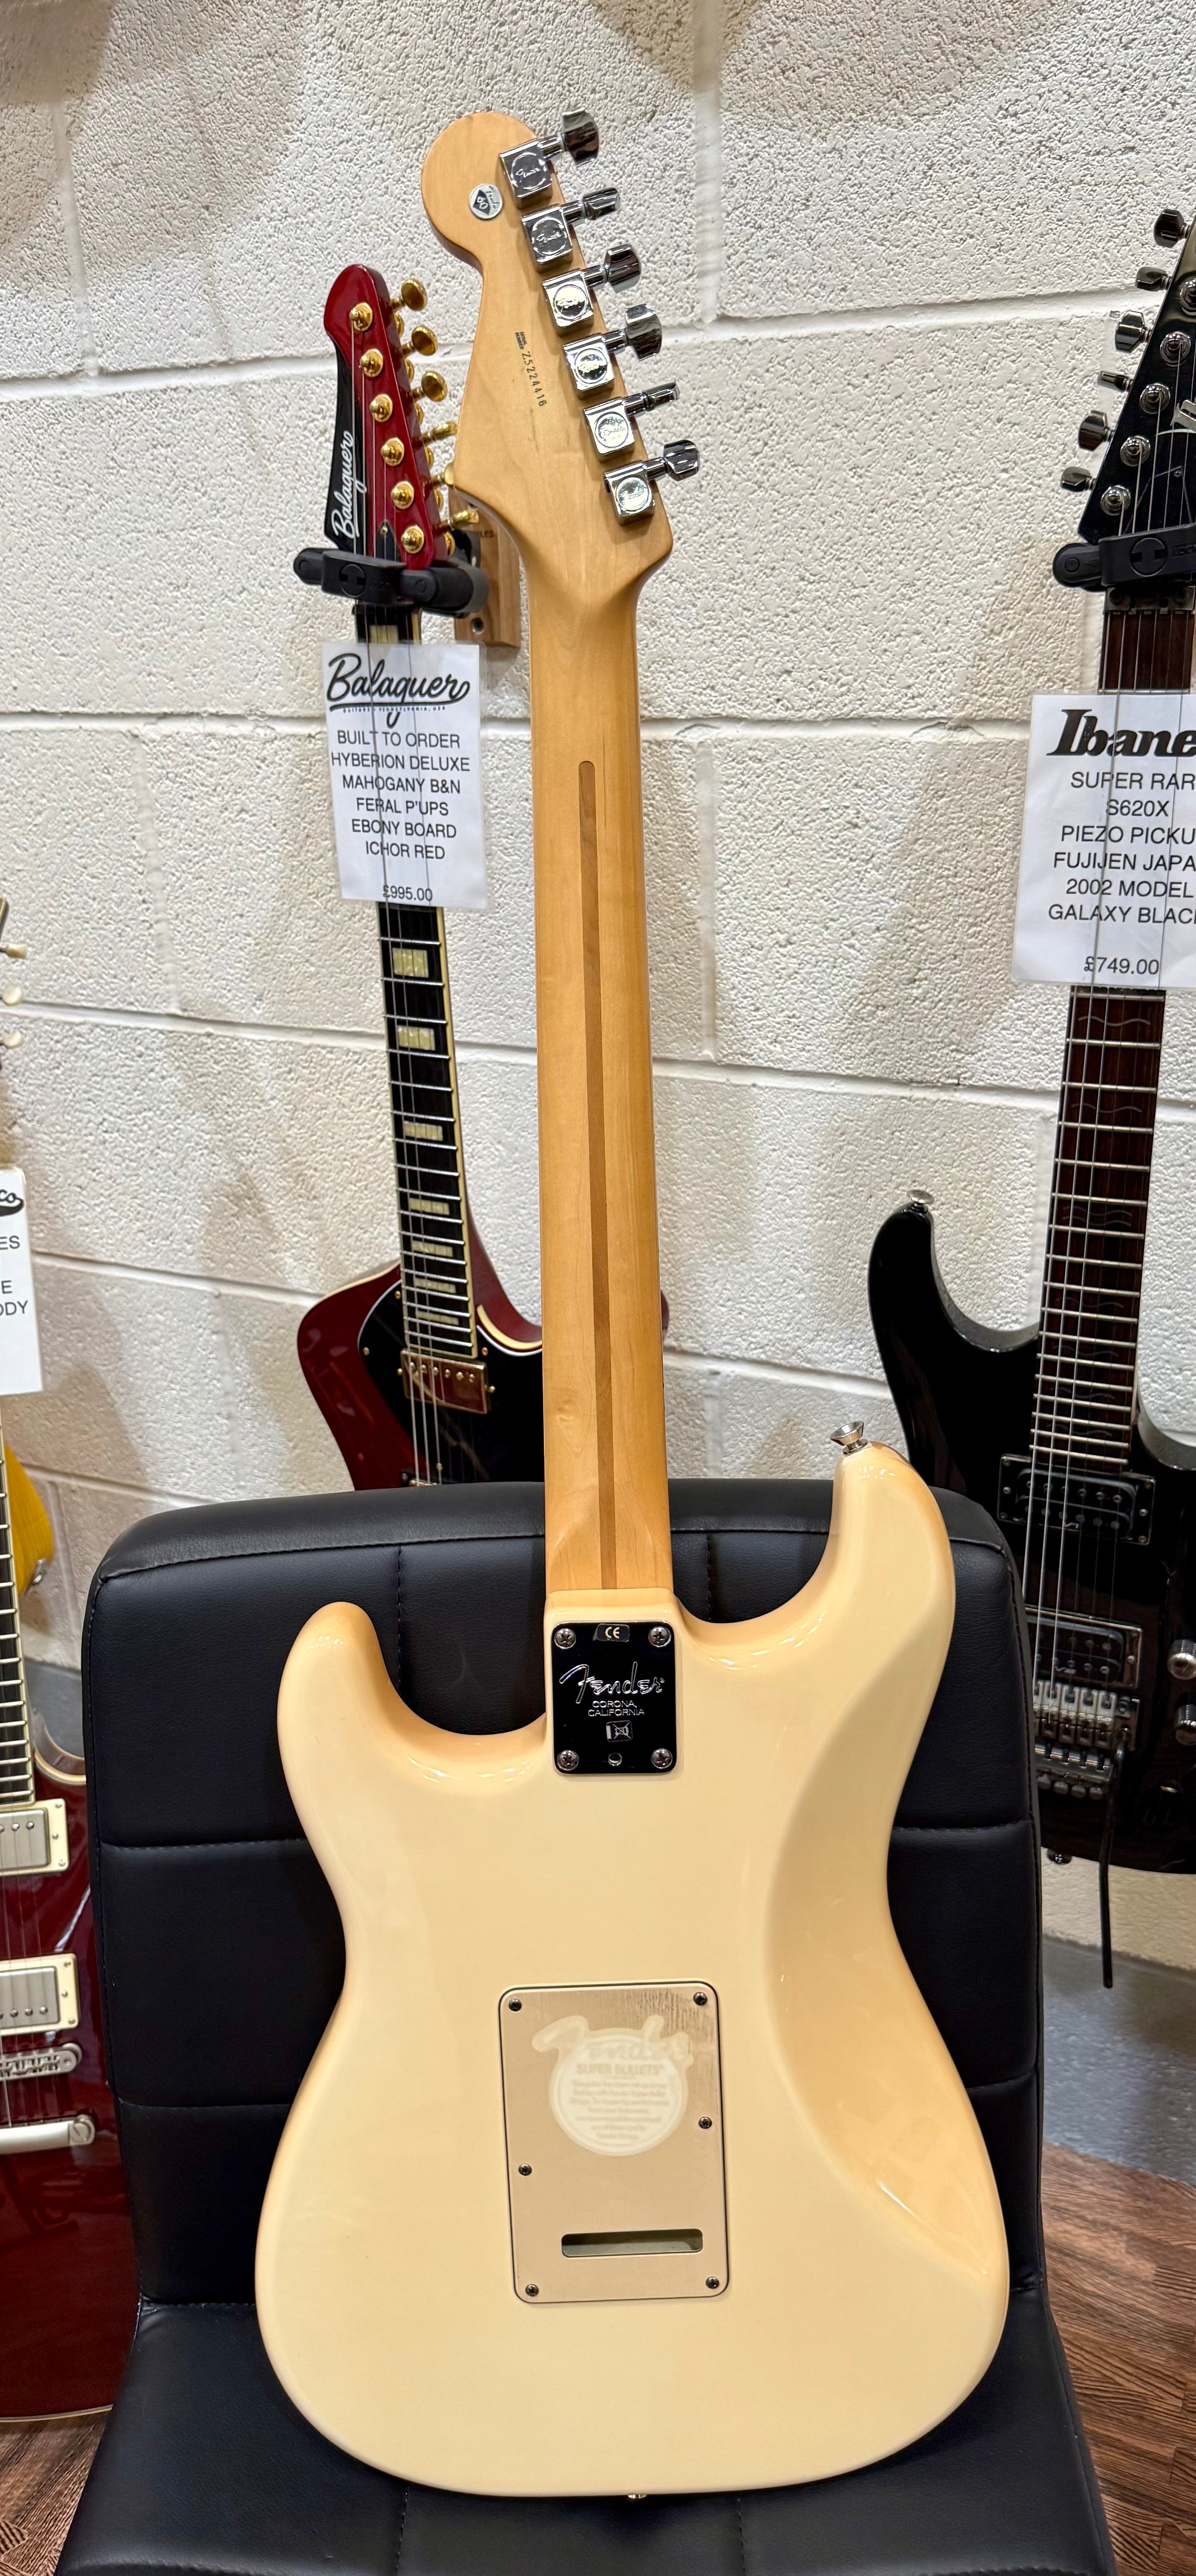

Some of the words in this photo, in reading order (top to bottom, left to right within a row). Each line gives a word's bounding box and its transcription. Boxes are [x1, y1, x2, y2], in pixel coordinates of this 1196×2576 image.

[522, 351, 547, 406] Z5224416
[331, 430, 367, 539] Balaguer
[327, 653, 470, 729] Balaguer
[337, 730, 378, 745] BUILT
[382, 731, 401, 746] TO
[406, 732, 460, 749] ORDER
[331, 752, 405, 769] HYBERION
[409, 756, 470, 772] DELUXE
[342, 775, 425, 792] MAHOGANY
[431, 779, 460, 794] B&N
[1071, 772, 1143, 790] SUPER
[1150, 773, 1196, 790] RAR
[356, 798, 401, 814] FERAL
[1106, 799, 1169, 817] S620X
[352, 819, 400, 835] EBONY
[405, 822, 457, 838] BOARD
[1061, 826, 1123, 842] PIEZO
[1130, 827, 1196, 845] PICKU
[366, 841, 409, 857] ICHOR
[415, 844, 445, 859] RED
[1053, 852, 1136, 870] FUJIJEN
[1143, 855, 1196, 871] JAPA
[383, 885, 433, 901] £995.00
[1066, 879, 1112, 895] 2002
[1118, 881, 1194, 898] MODEL
[1048, 905, 1131, 922] GALAXY
[1138, 907, 1196, 925] BLAC
[1084, 956, 1159, 975] £749.00
[605, 1626, 620, 1639] CE
[588, 1708, 645, 1717] CALIFORNIA
[592, 1700, 637, 1708] CORONA,
